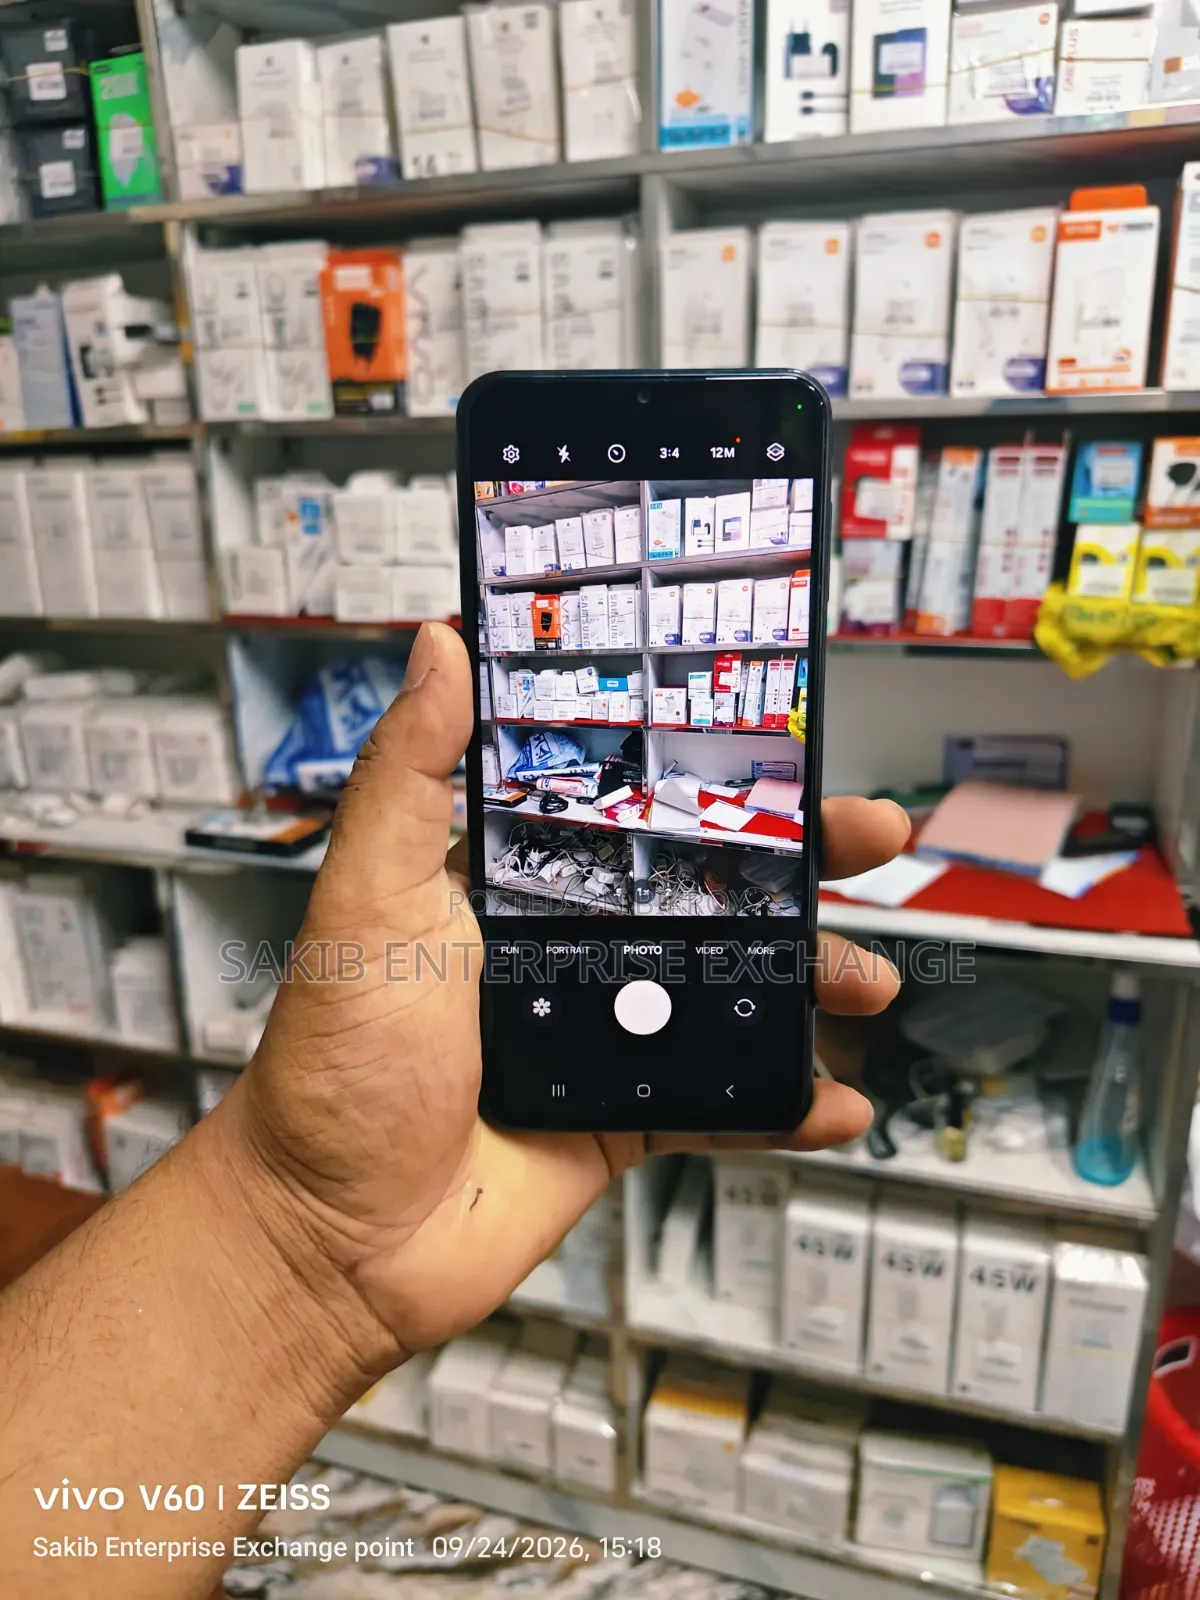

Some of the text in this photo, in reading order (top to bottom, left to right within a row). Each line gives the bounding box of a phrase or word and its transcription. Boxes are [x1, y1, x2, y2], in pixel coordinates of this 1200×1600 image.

[659, 447, 680, 459] 3:4
[709, 446, 735, 459] 12M
[500, 946, 519, 955] FUN
[545, 946, 590, 955] PORTRAIT
[623, 945, 663, 955] PHOTO
[695, 946, 724, 955] VIDEO
[747, 946, 775, 955] MORE
[882, 1250, 944, 1279] 45W
[970, 1265, 1037, 1293] 45W
